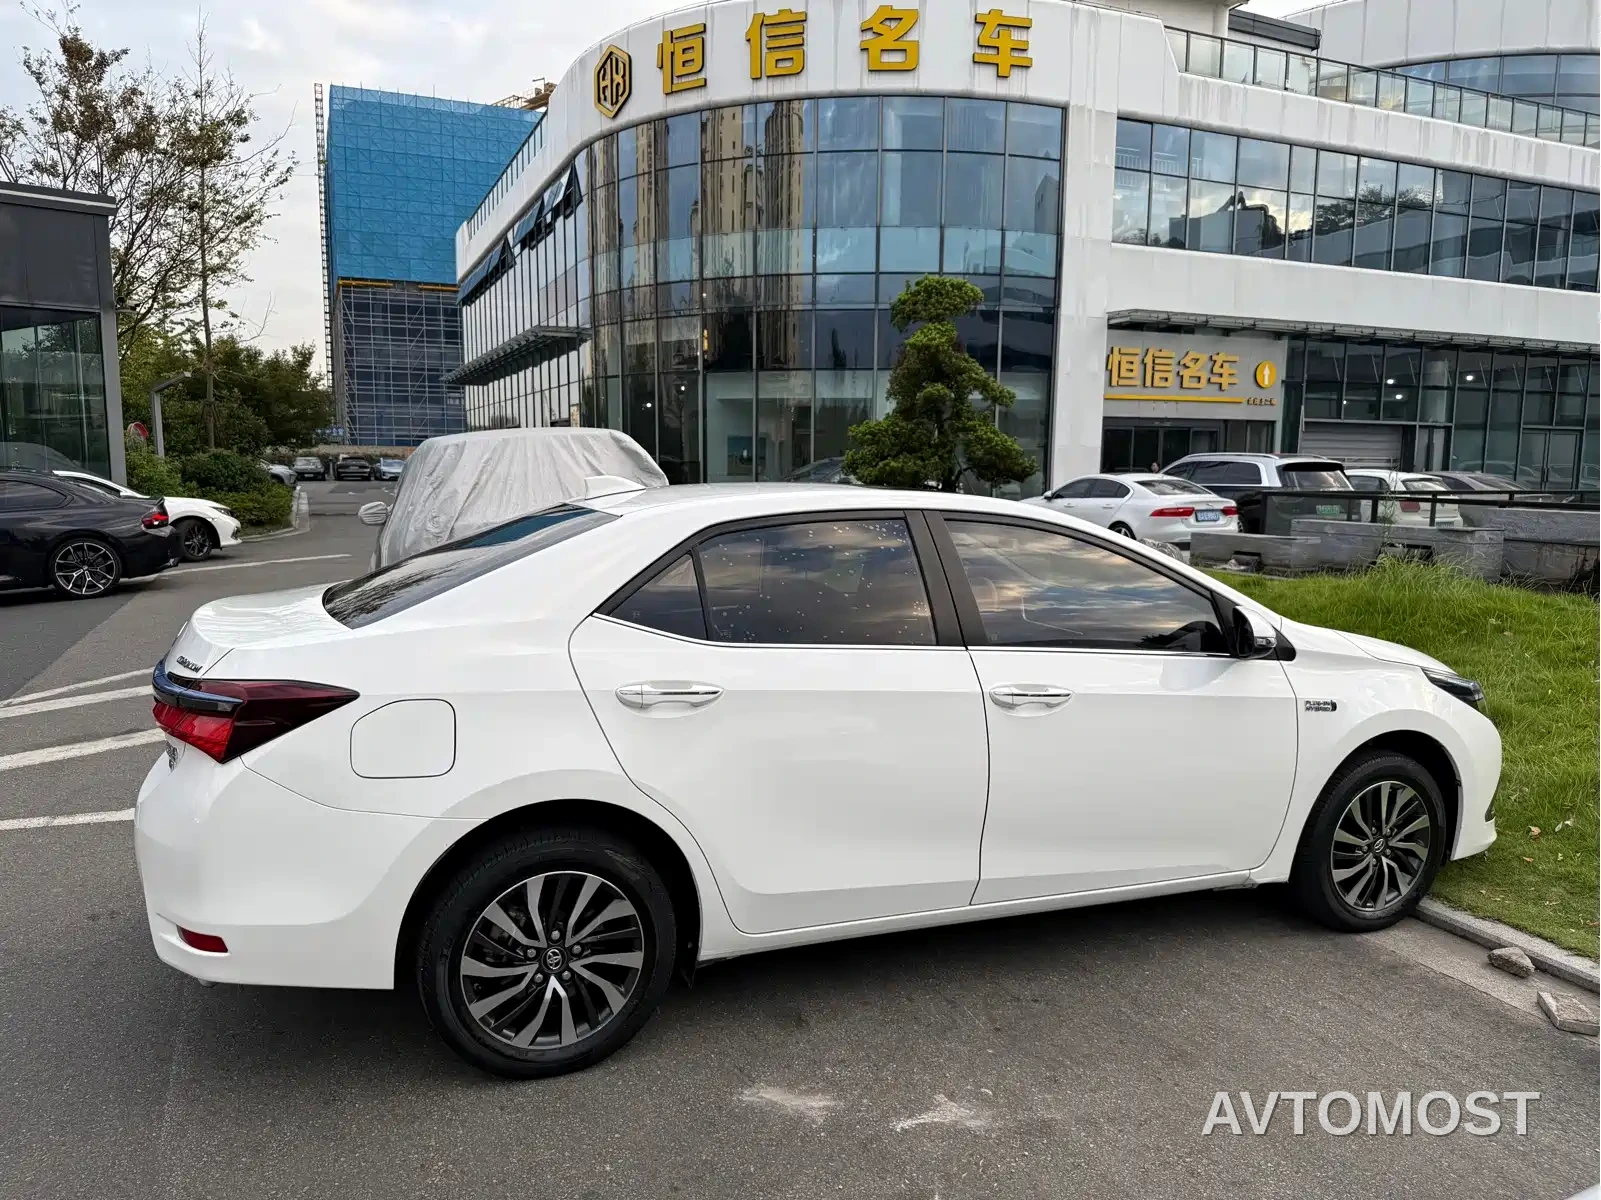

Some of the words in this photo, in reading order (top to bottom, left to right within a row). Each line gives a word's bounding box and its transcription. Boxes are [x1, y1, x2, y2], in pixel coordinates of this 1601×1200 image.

[656, 4, 1033, 95] 恒信名车
[1107, 346, 1240, 391] 恒信名车
